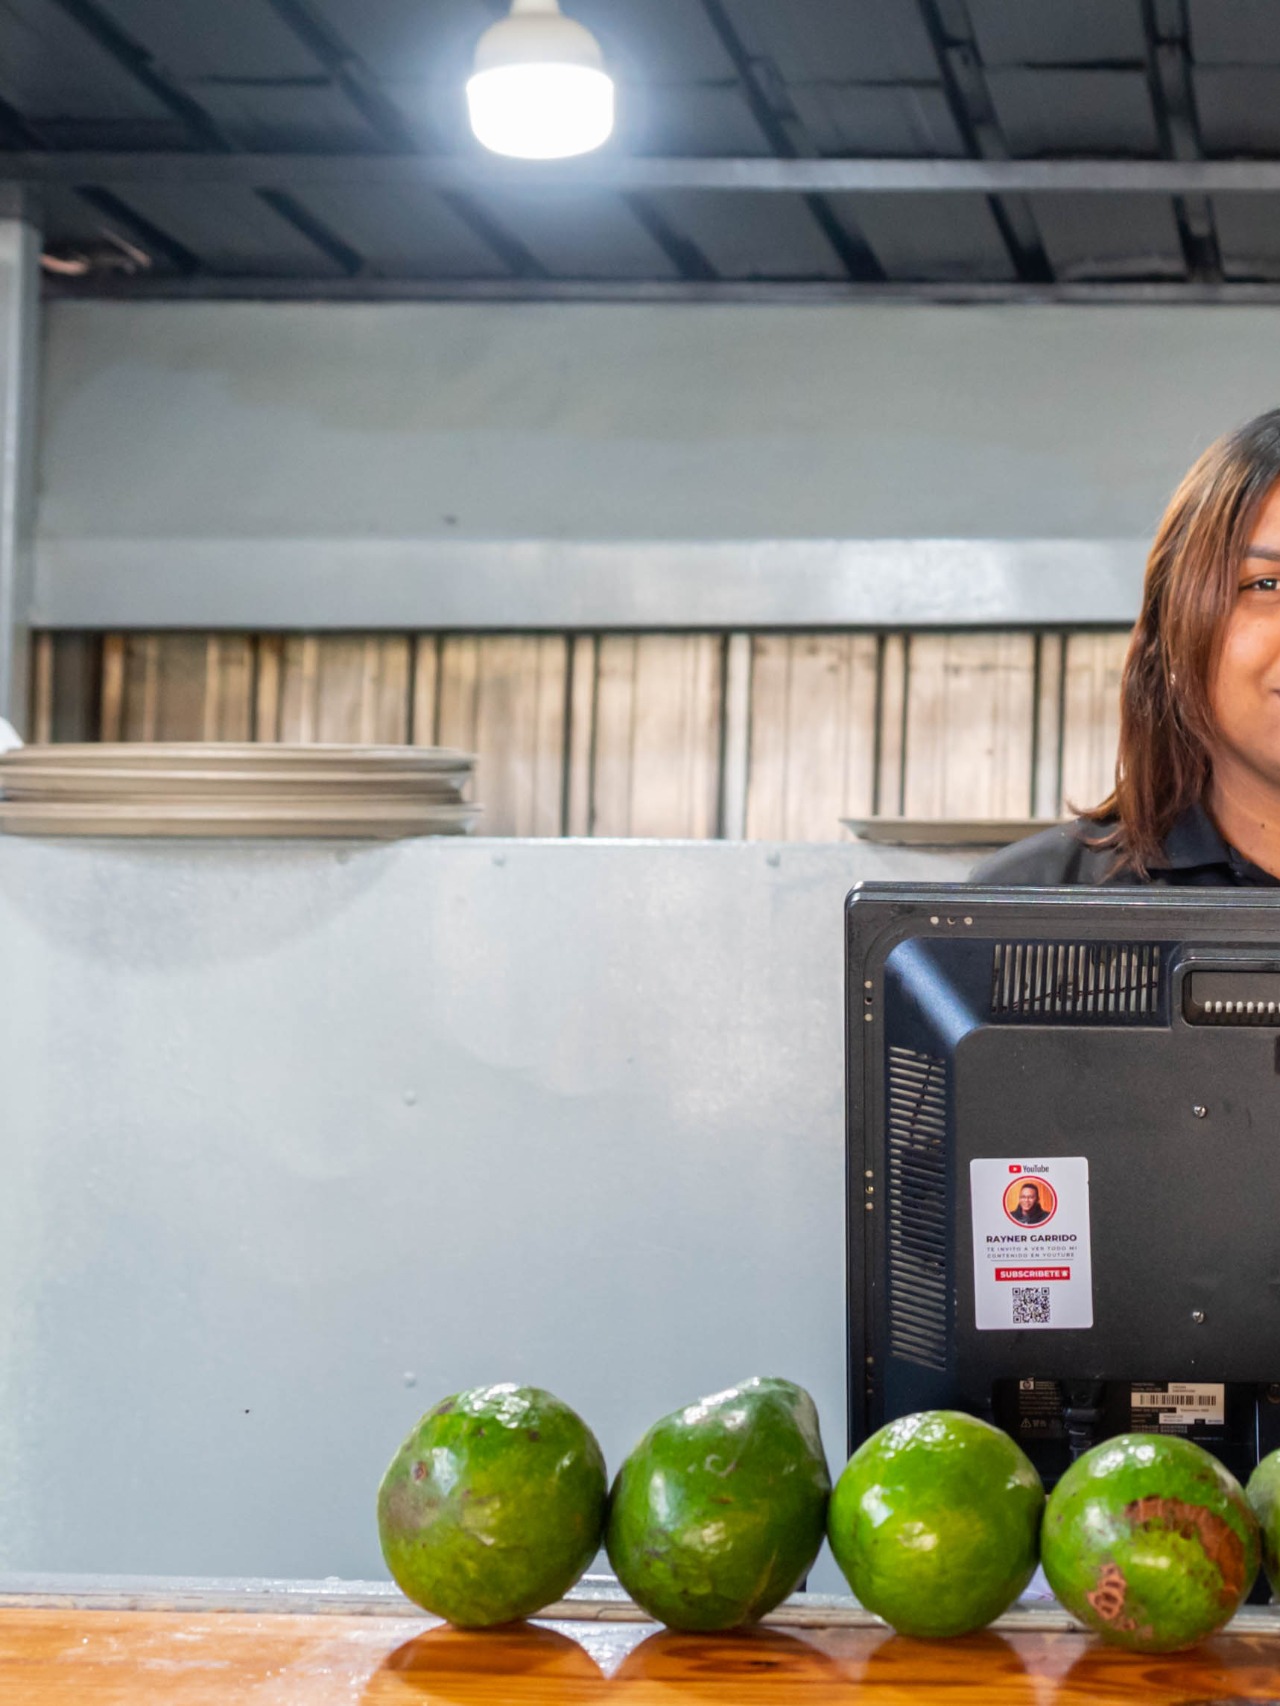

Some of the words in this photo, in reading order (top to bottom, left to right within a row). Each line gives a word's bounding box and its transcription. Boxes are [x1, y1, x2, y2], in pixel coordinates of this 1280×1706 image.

[1023, 1165, 1049, 1173] YouTube
[986, 1235, 1027, 1243] RAYNER
[1030, 1234, 1077, 1242] GARRIDO
